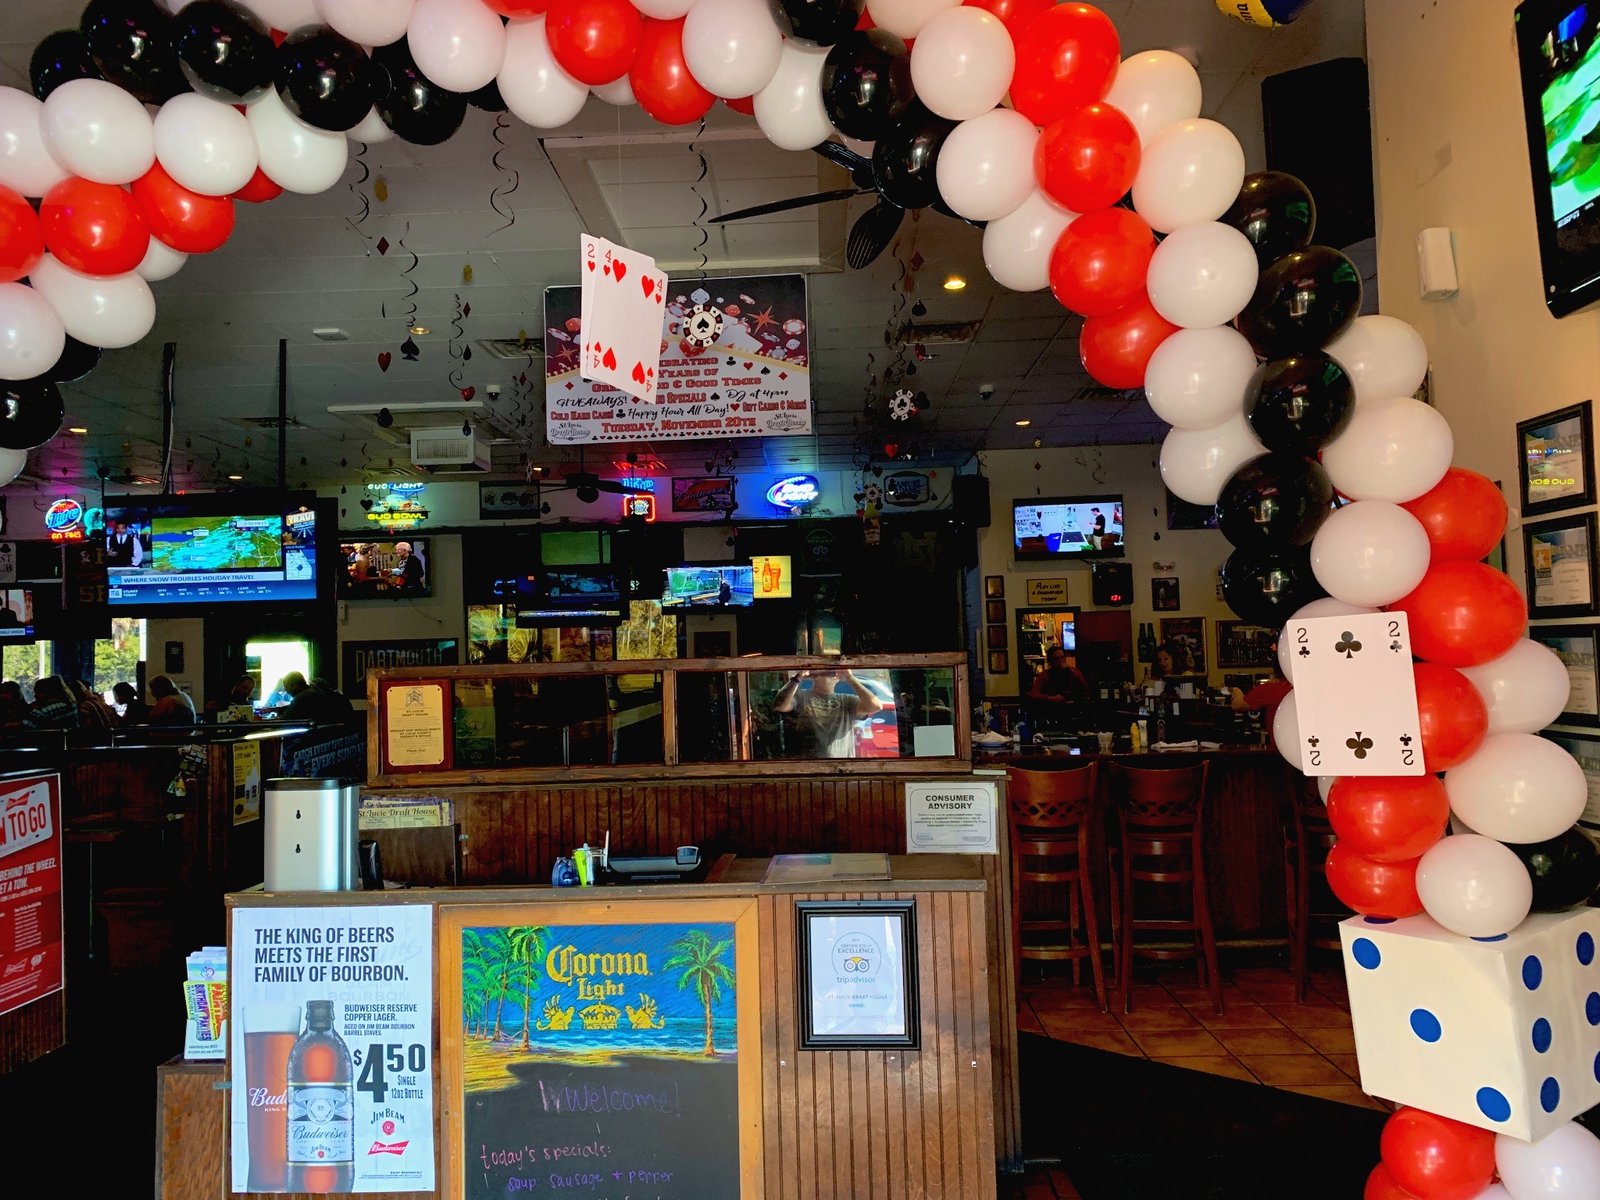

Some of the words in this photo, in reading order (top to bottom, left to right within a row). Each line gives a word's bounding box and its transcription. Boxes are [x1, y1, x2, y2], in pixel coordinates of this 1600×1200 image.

[587, 243, 595, 258] 2
[604, 249, 612, 262] 4
[656, 278, 663, 292] 4
[722, 377, 761, 386] TIMES
[628, 407, 658, 420] Happy
[661, 406, 684, 417] Hour
[687, 405, 701, 416] All
[703, 404, 729, 417] Day!
[661, 419, 722, 430] NOVEMBER
[393, 482, 423, 490] LIGHT
[1297, 627, 1309, 643] 2
[1388, 620, 1401, 637] 2
[1310, 751, 1321, 766] 2
[1402, 749, 1414, 766] 2
[388, 807, 410, 816] Draft
[411, 807, 436, 816] House
[9, 810, 27, 840] TO
[29, 803, 46, 833] GO
[24, 862, 35, 875] THE
[255, 928, 281, 944] THE
[286, 928, 322, 944] KING
[326, 927, 345, 943] OF
[348, 927, 394, 943] BEERS
[255, 947, 301, 963] MEETS
[306, 947, 334, 963] THE
[337, 946, 378, 962] FIRST
[545, 945, 649, 986] Corona
[255, 967, 304, 983] FAMILY
[309, 966, 327, 982] OF
[331, 965, 409, 981] BOURBON.
[836, 976, 876, 984] tripadvisor
[576, 978, 625, 1001] Light
[344, 1004, 386, 1012] BUDWEISER
[387, 1004, 418, 1012] RESERVE
[344, 1013, 372, 1021] COPPER
[373, 1013, 397, 1021] LAGER.
[397, 1074, 416, 1086] SINGLE
[249, 1087, 287, 1107] Bud
[404, 1088, 424, 1099] BOTTLE
[371, 1111, 385, 1124] JIM
[385, 1108, 405, 1124] BEAM
[291, 1125, 348, 1139] Budweiser
[371, 1143, 406, 1152] Budweiser
[480, 1145, 536, 1170] today's
[544, 1142, 612, 1161] specials:
[550, 1172, 604, 1190] sausage
[629, 1169, 674, 1185] pepper
